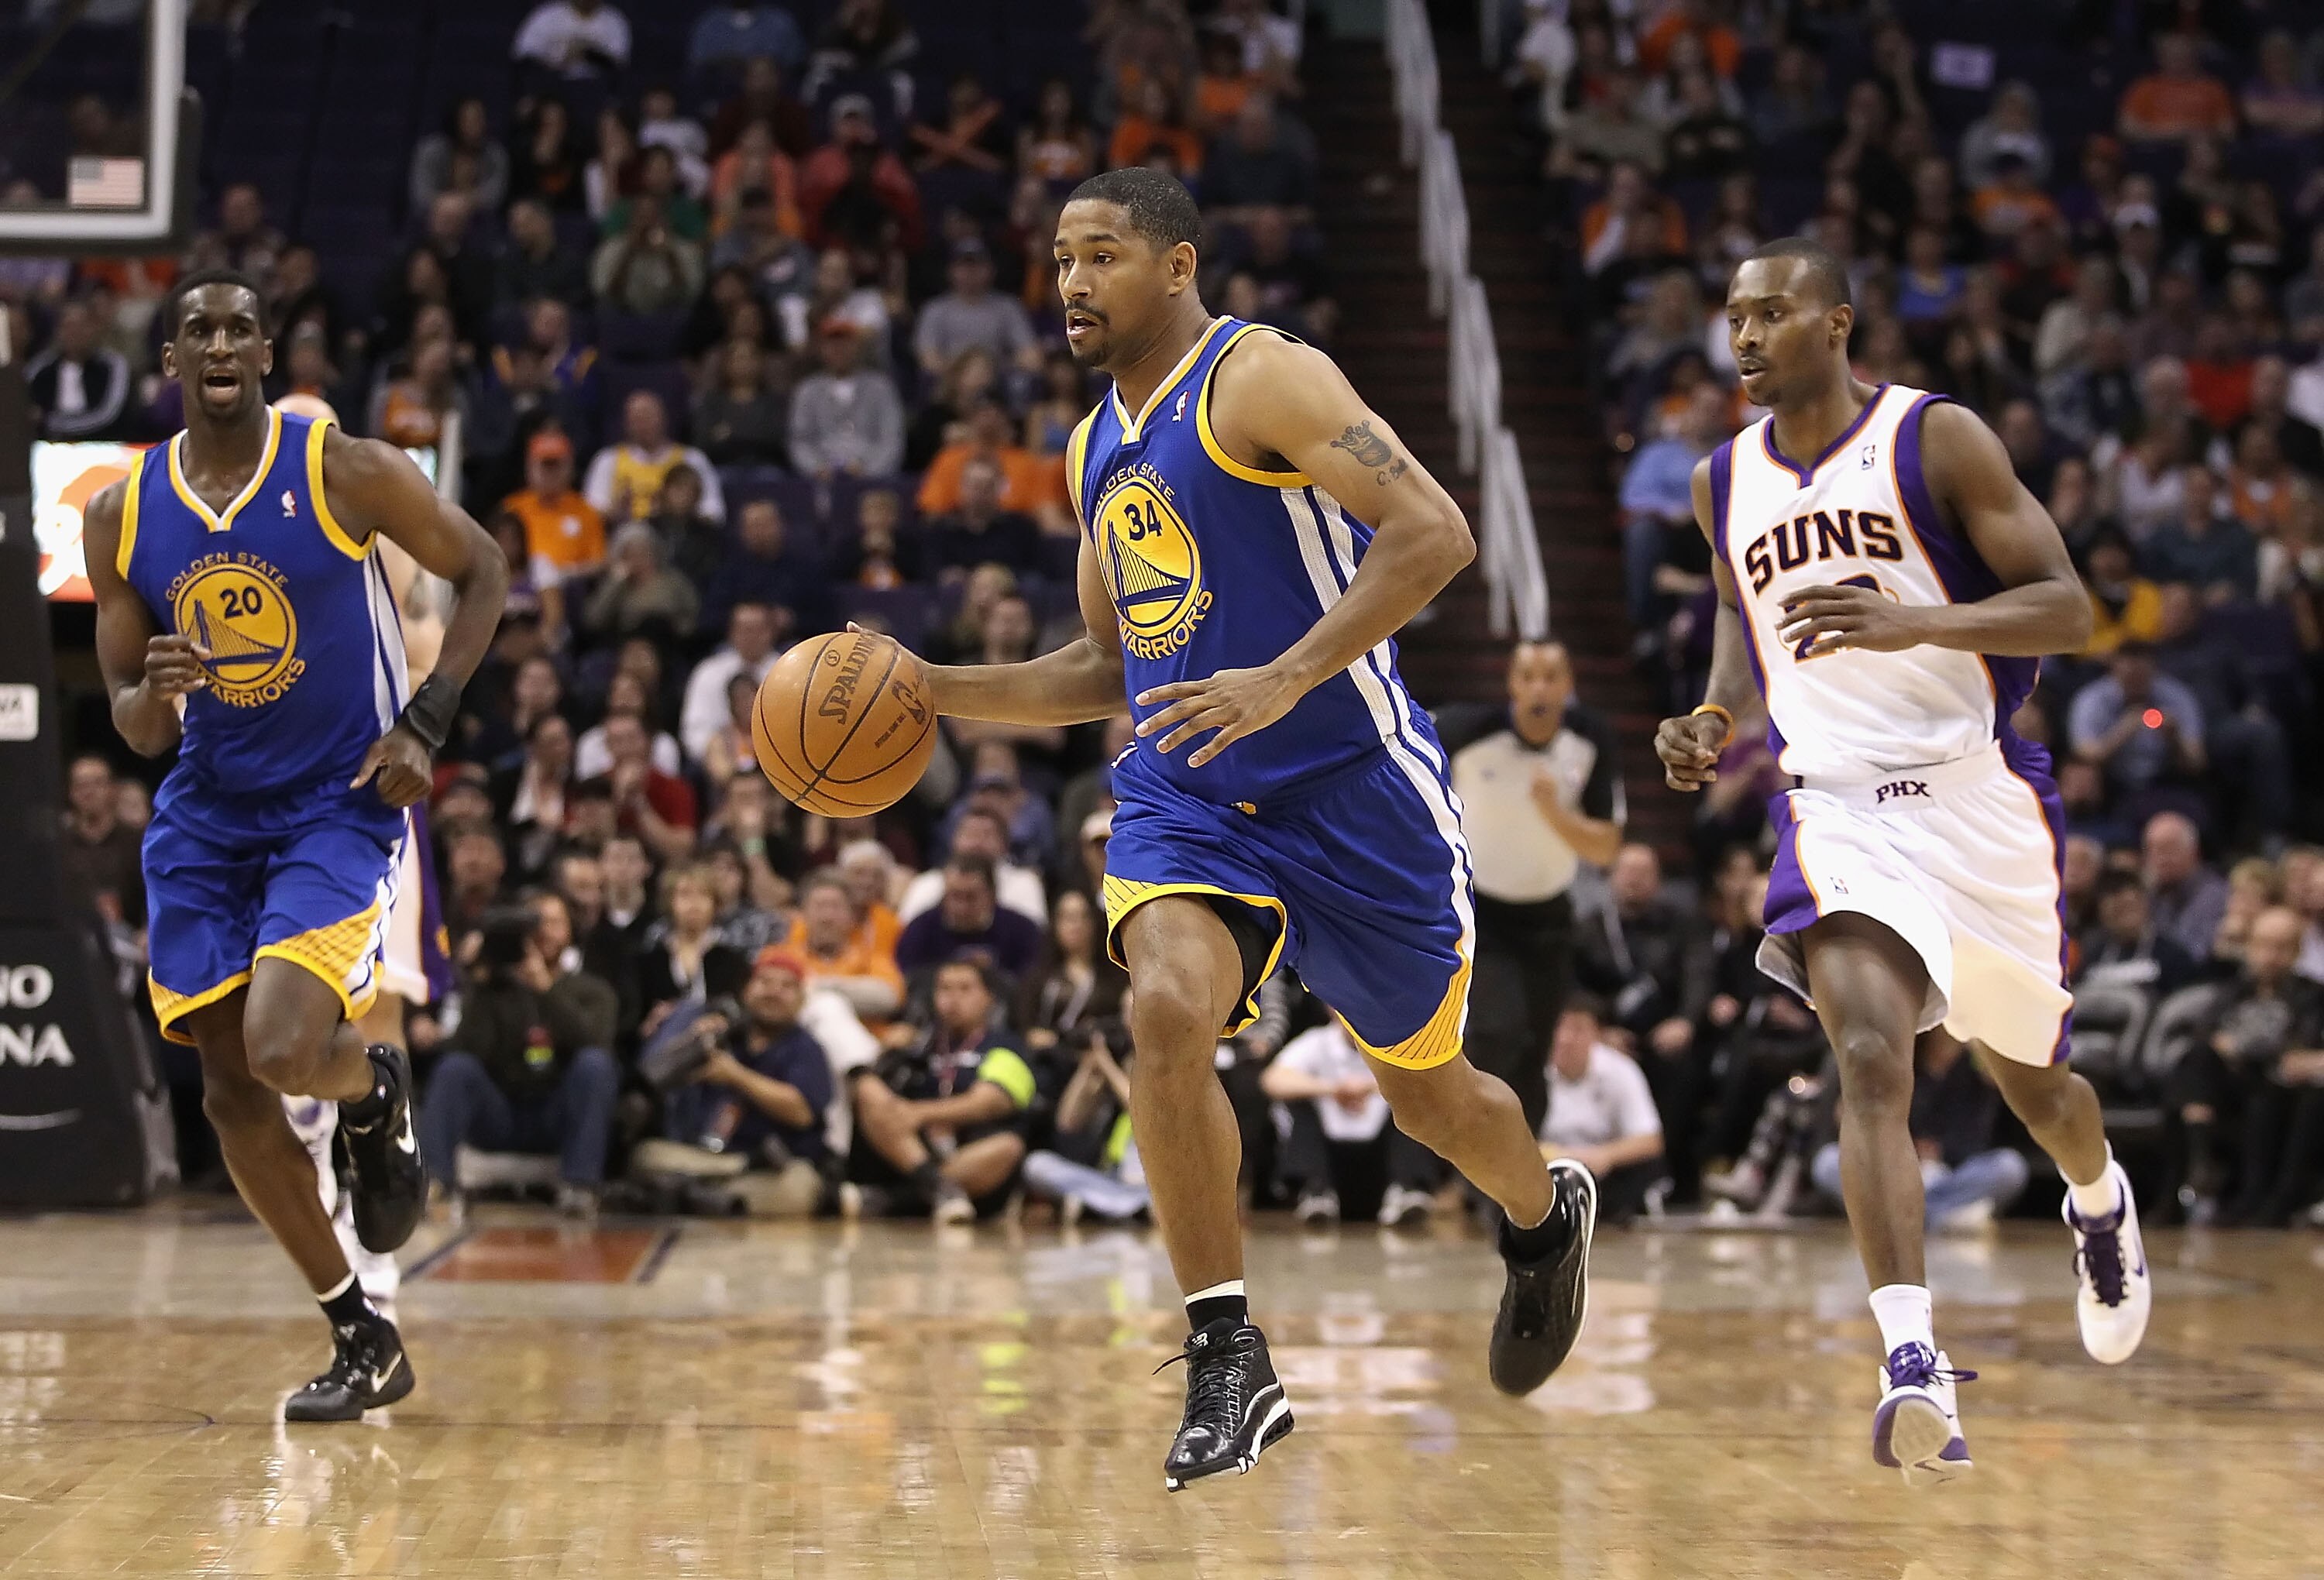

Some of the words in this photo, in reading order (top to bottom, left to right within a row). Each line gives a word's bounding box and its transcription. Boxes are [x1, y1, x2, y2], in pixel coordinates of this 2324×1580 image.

[1139, 462, 1175, 502] STATE
[1123, 500, 1163, 541] 34
[165, 551, 230, 601] GOLDEN
[236, 551, 289, 588] STATE
[1745, 509, 1903, 599] SUNS
[219, 586, 263, 620] 20
[1118, 587, 1214, 661] WARRIORS
[819, 632, 875, 725] SPALDIN
[1875, 779, 1932, 805] PHX
